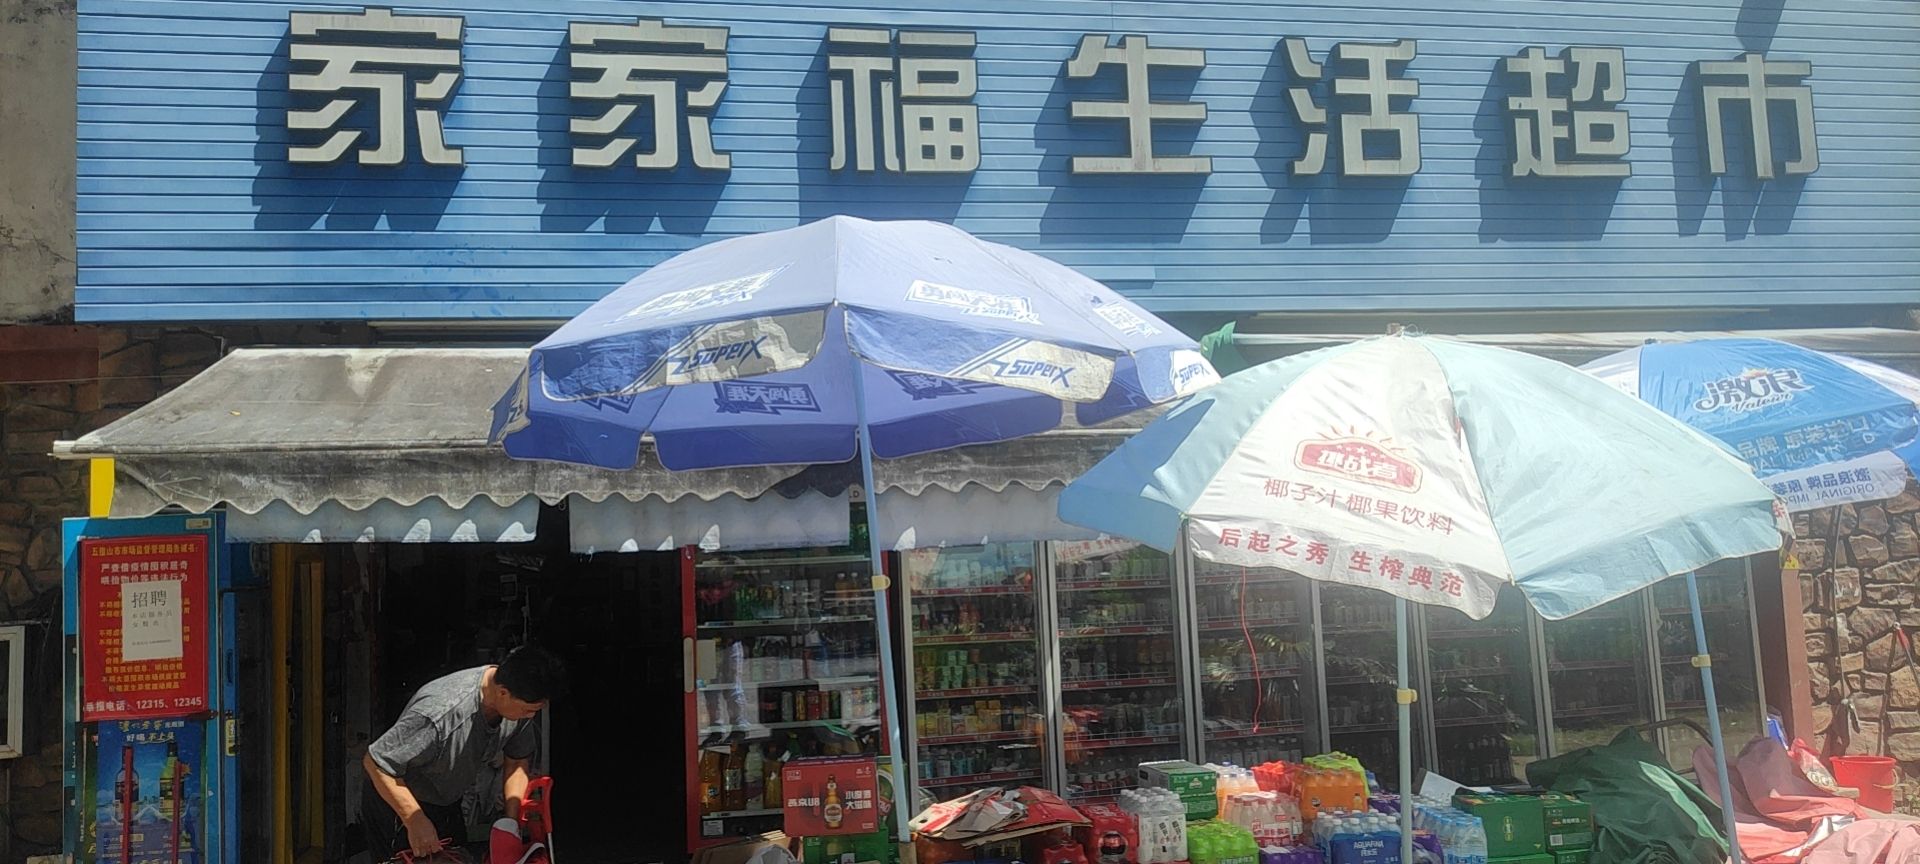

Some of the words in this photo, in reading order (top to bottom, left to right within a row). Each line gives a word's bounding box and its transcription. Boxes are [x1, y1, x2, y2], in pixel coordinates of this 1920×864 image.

[288, 7, 1820, 180] 家家福生活超市
[1695, 369, 1807, 411] 激浪
[1316, 450, 1398, 480] 挑战者
[1219, 527, 1330, 565] 后起之秀
[1348, 550, 1465, 597] 生榨典范
[131, 589, 167, 609] 招聘
[1353, 840, 1384, 849] AQUAFINA
